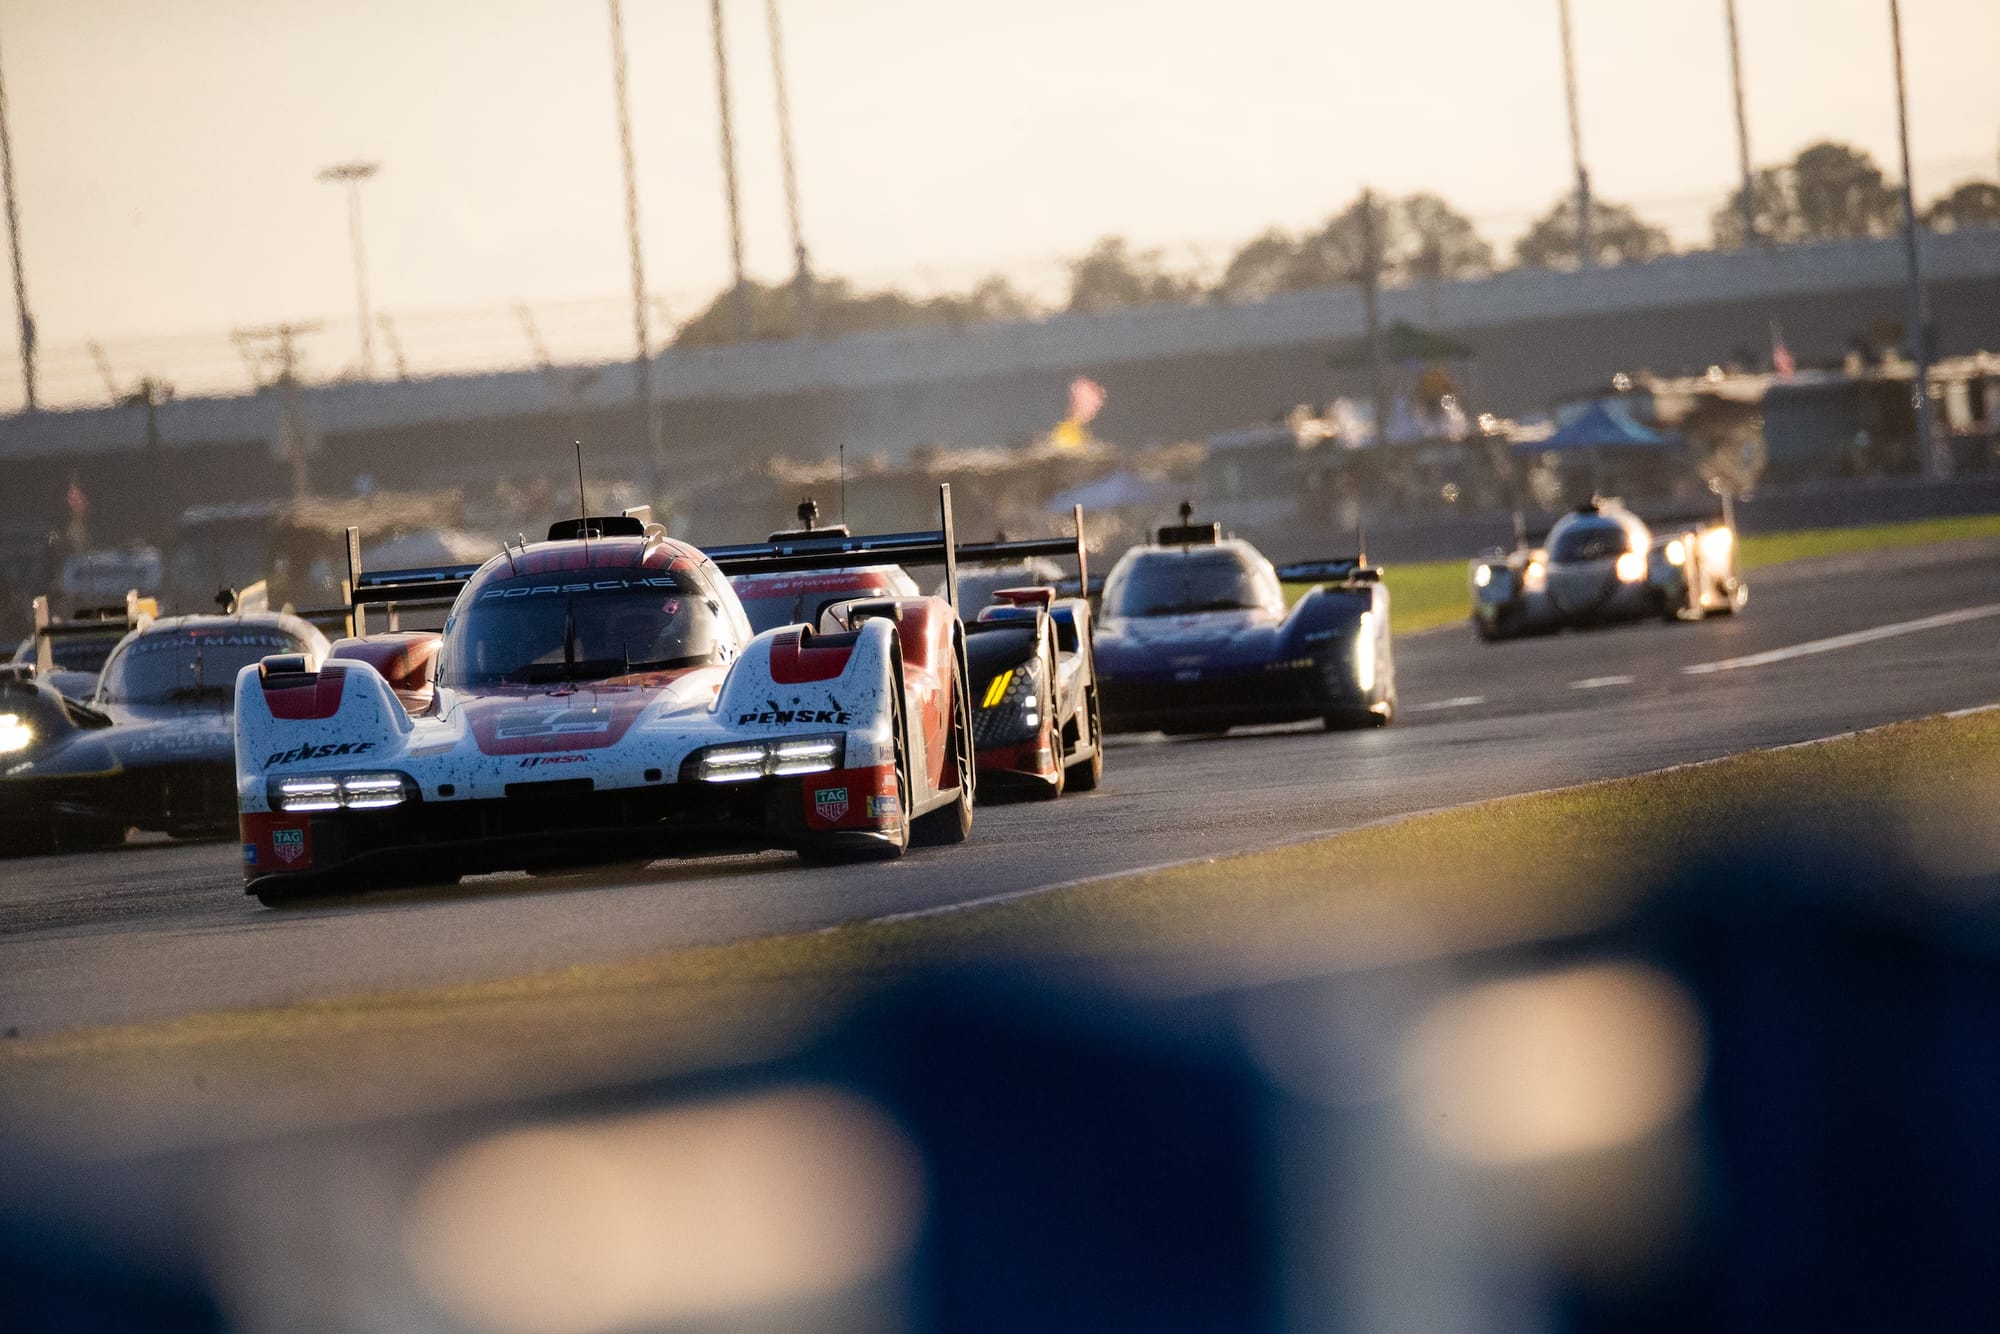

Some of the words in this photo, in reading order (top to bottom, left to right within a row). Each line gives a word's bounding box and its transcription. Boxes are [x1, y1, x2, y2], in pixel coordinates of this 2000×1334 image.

[480, 577, 677, 600] PORSCHE
[737, 710, 852, 725] PENSKE
[263, 742, 376, 769] PENSKE
[539, 755, 588, 766] IMSA
[817, 790, 845, 802] TAG
[818, 802, 847, 819] HEUER
[275, 831, 301, 843] TAG
[275, 843, 303, 861] HEUER
